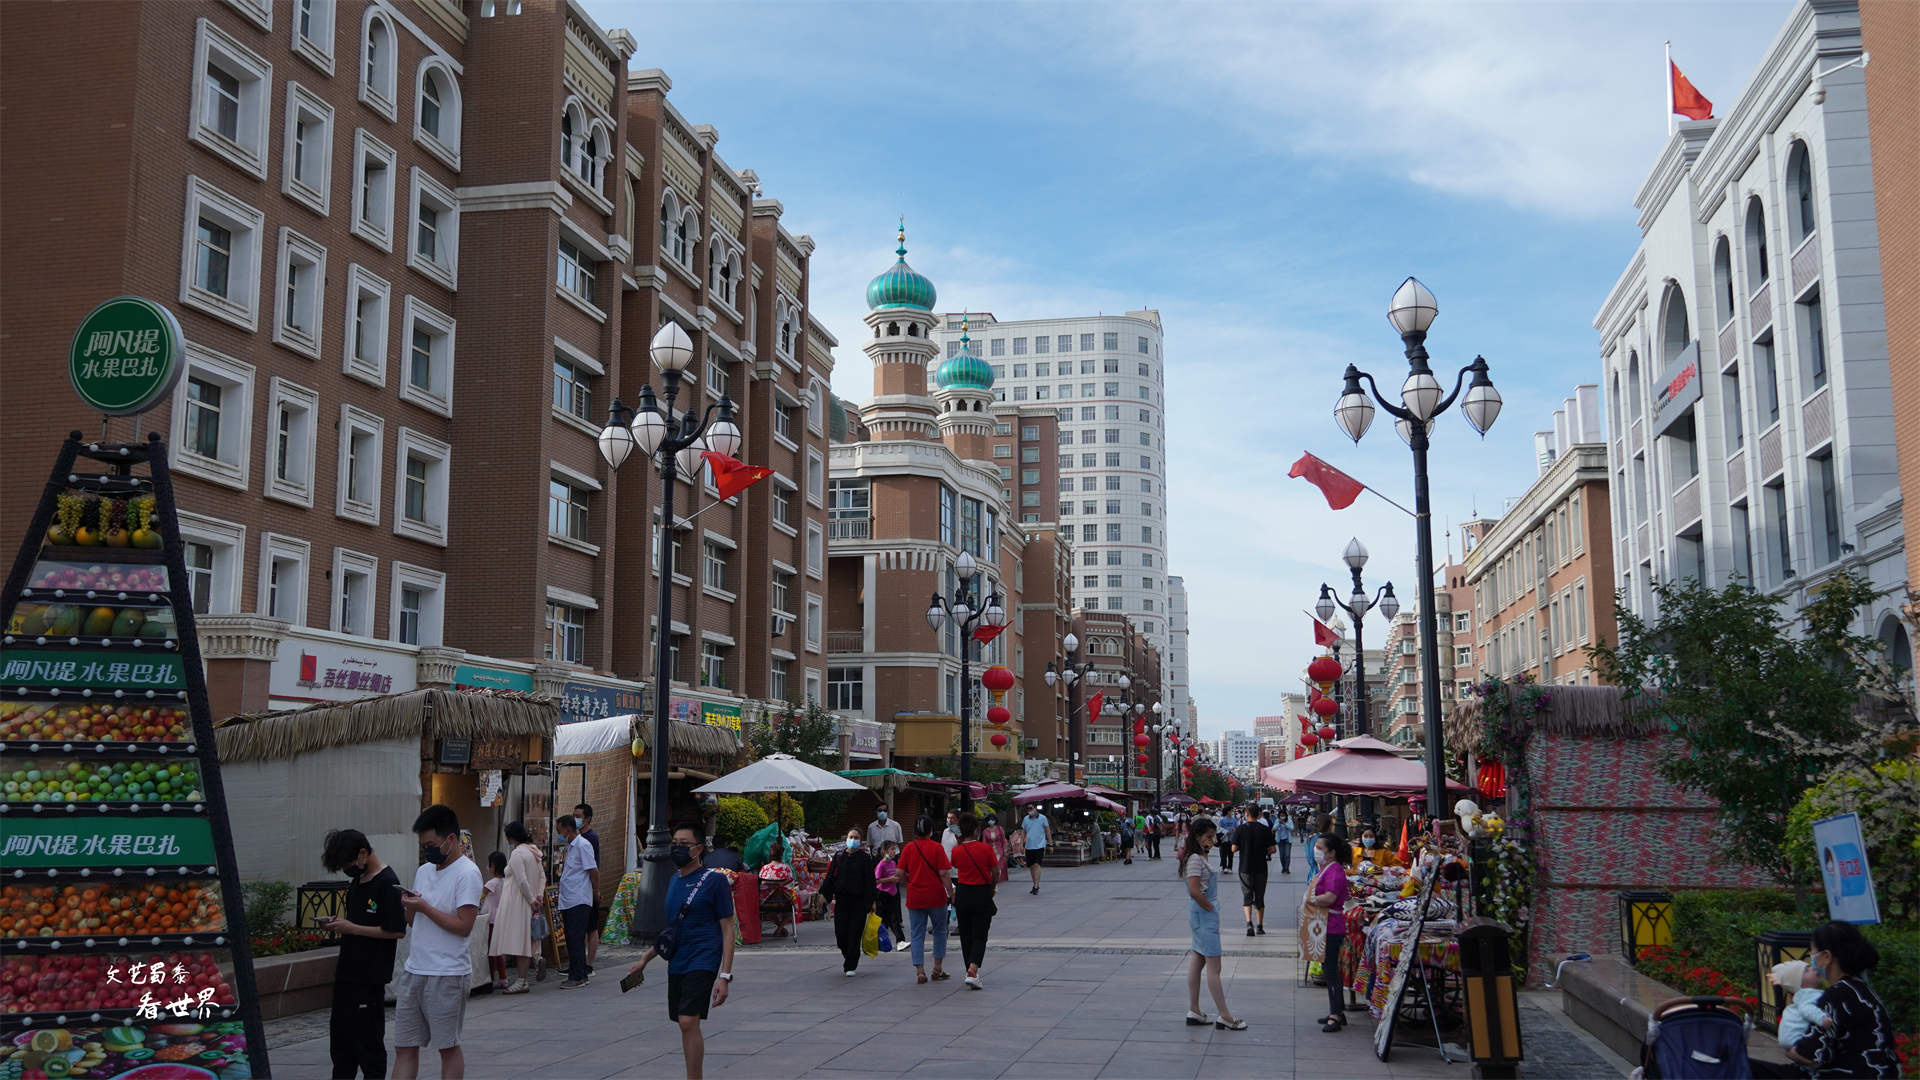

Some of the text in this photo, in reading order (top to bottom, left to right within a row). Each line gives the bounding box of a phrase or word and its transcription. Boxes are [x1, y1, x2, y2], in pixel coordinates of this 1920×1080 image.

[84, 329, 160, 357] 阿凡提
[80, 357, 158, 379] 水果巴扎
[0, 659, 178, 684] 阿凡提 水果巴扎
[1, 834, 180, 856] 阿凡提 水果巴扎
